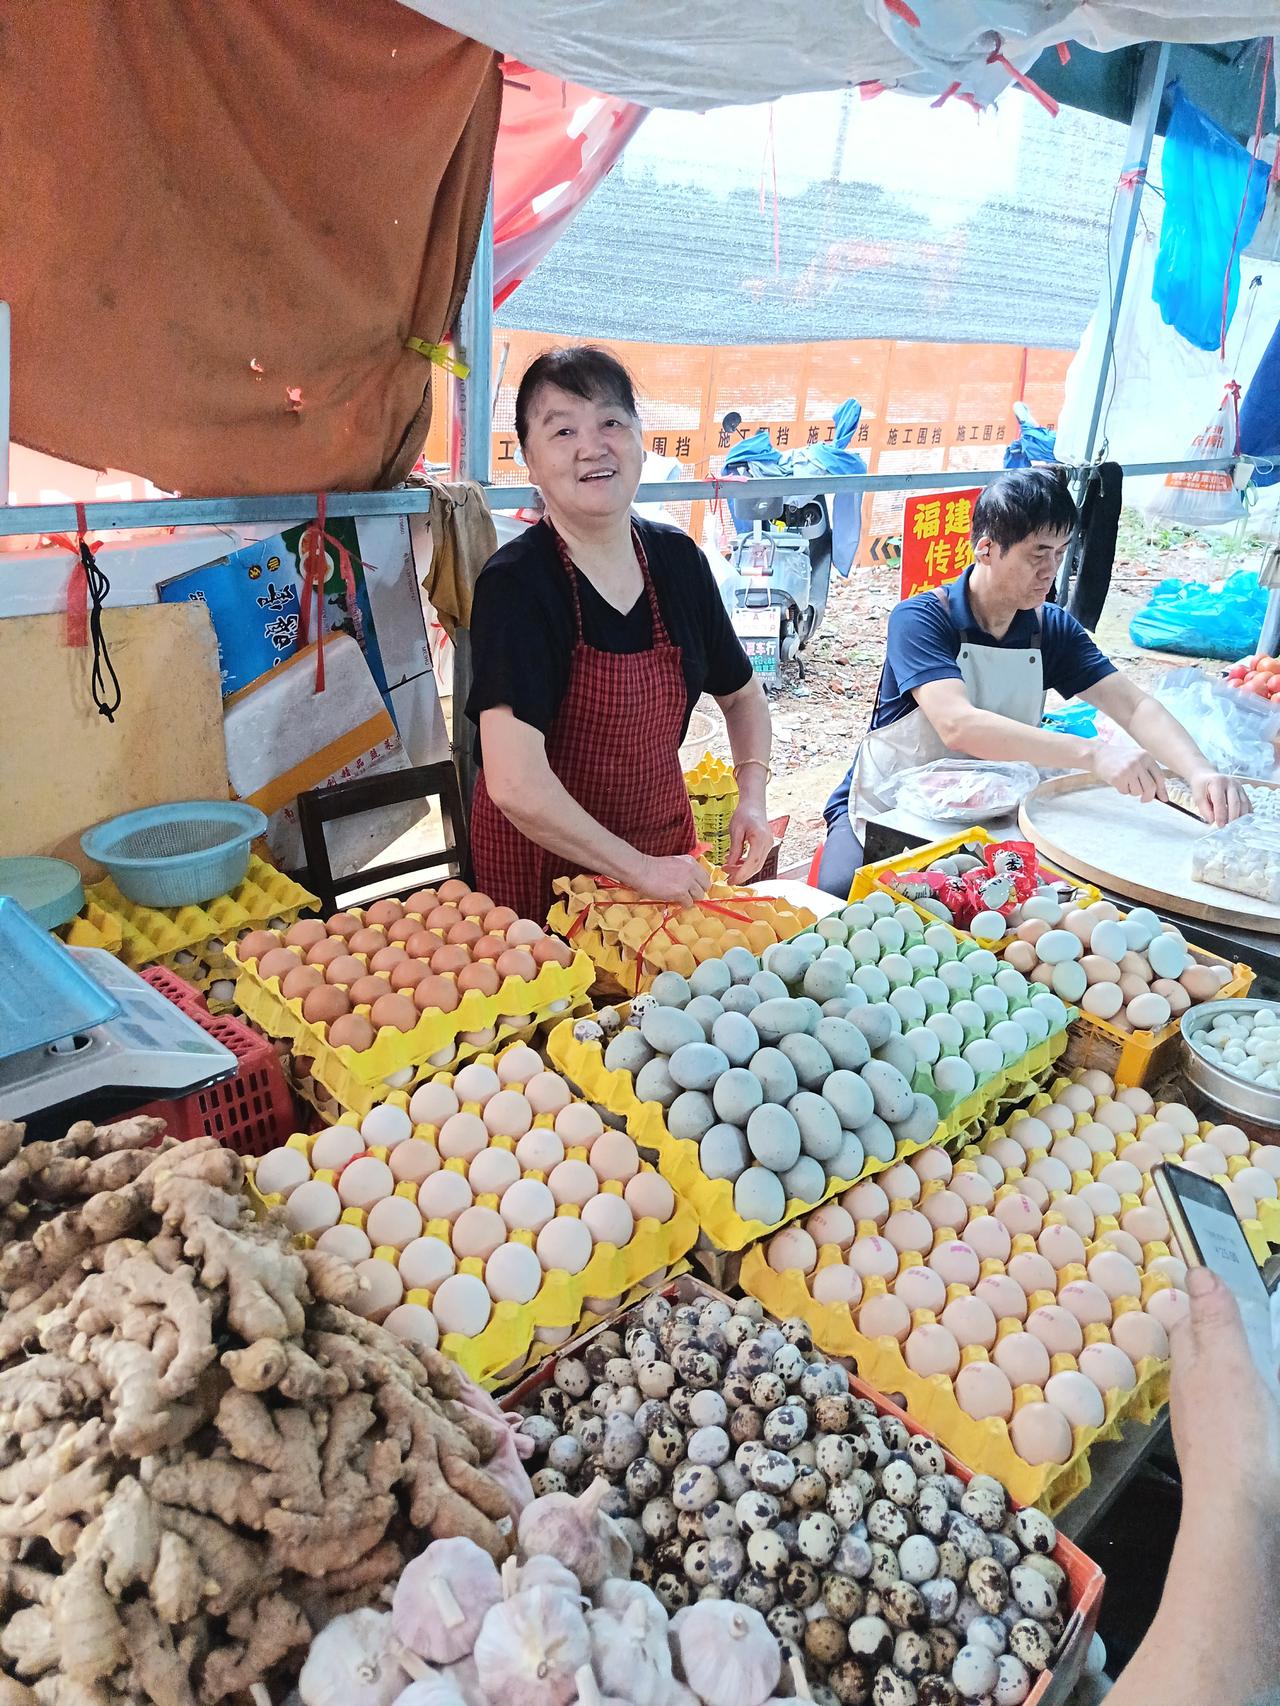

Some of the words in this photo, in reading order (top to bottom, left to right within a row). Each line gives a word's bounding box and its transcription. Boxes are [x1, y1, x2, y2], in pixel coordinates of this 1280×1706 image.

[717, 425, 790, 448] 施工挡
[806, 423, 870, 445] 施工挡
[886, 426, 943, 446] 施工围挡
[955, 424, 1006, 443] 施工围挡
[652, 436, 690, 458] 围挡
[912, 498, 972, 541] 福建
